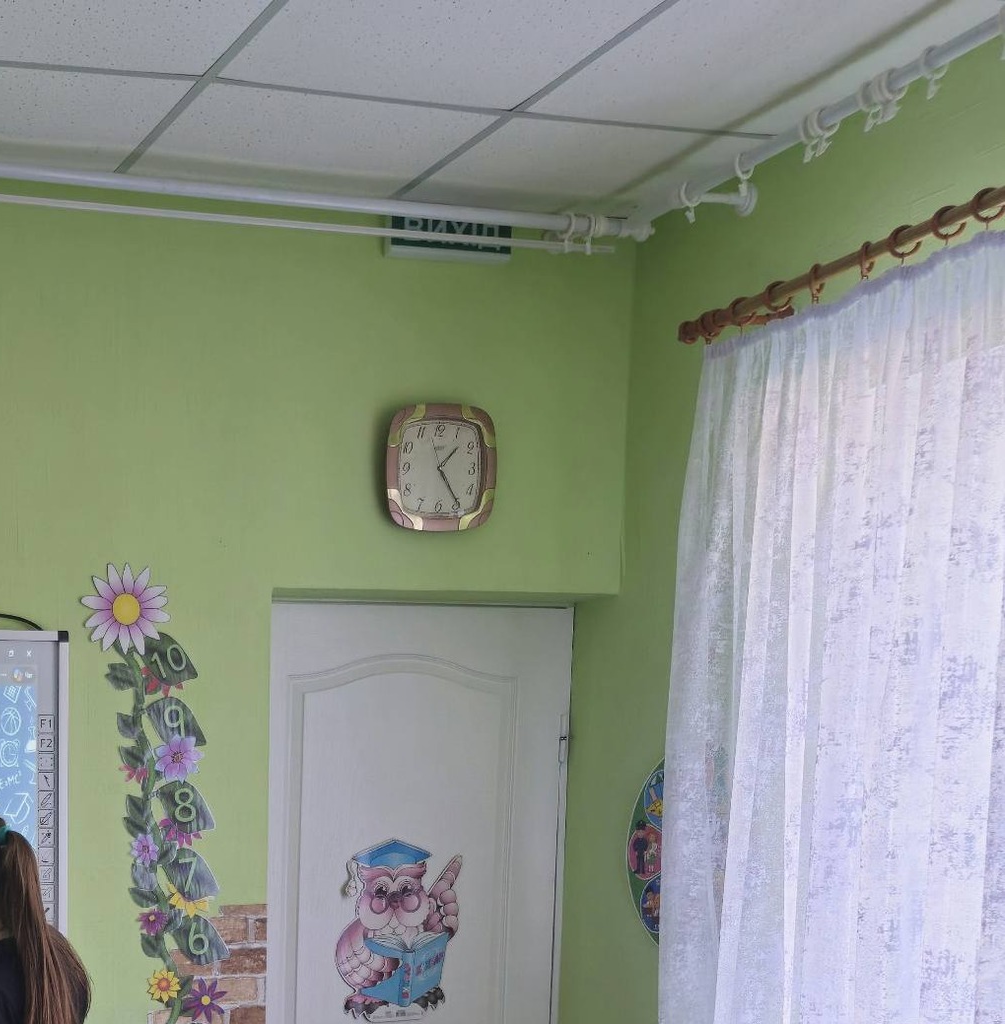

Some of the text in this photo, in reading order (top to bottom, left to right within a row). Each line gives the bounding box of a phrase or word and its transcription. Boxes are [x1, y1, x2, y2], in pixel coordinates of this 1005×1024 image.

[434, 424, 445, 437] 12
[403, 441, 413, 454] 10
[402, 462, 411, 475] 9
[468, 462, 476, 475] 3
[403, 483, 412, 496] 8
[150, 644, 187, 678] 10
[40, 718, 53, 729] F1
[164, 705, 185, 737] 9
[40, 738, 53, 748] F2
[174, 788, 196, 823] 8
[179, 855, 198, 891] 7
[188, 921, 209, 955] 6
